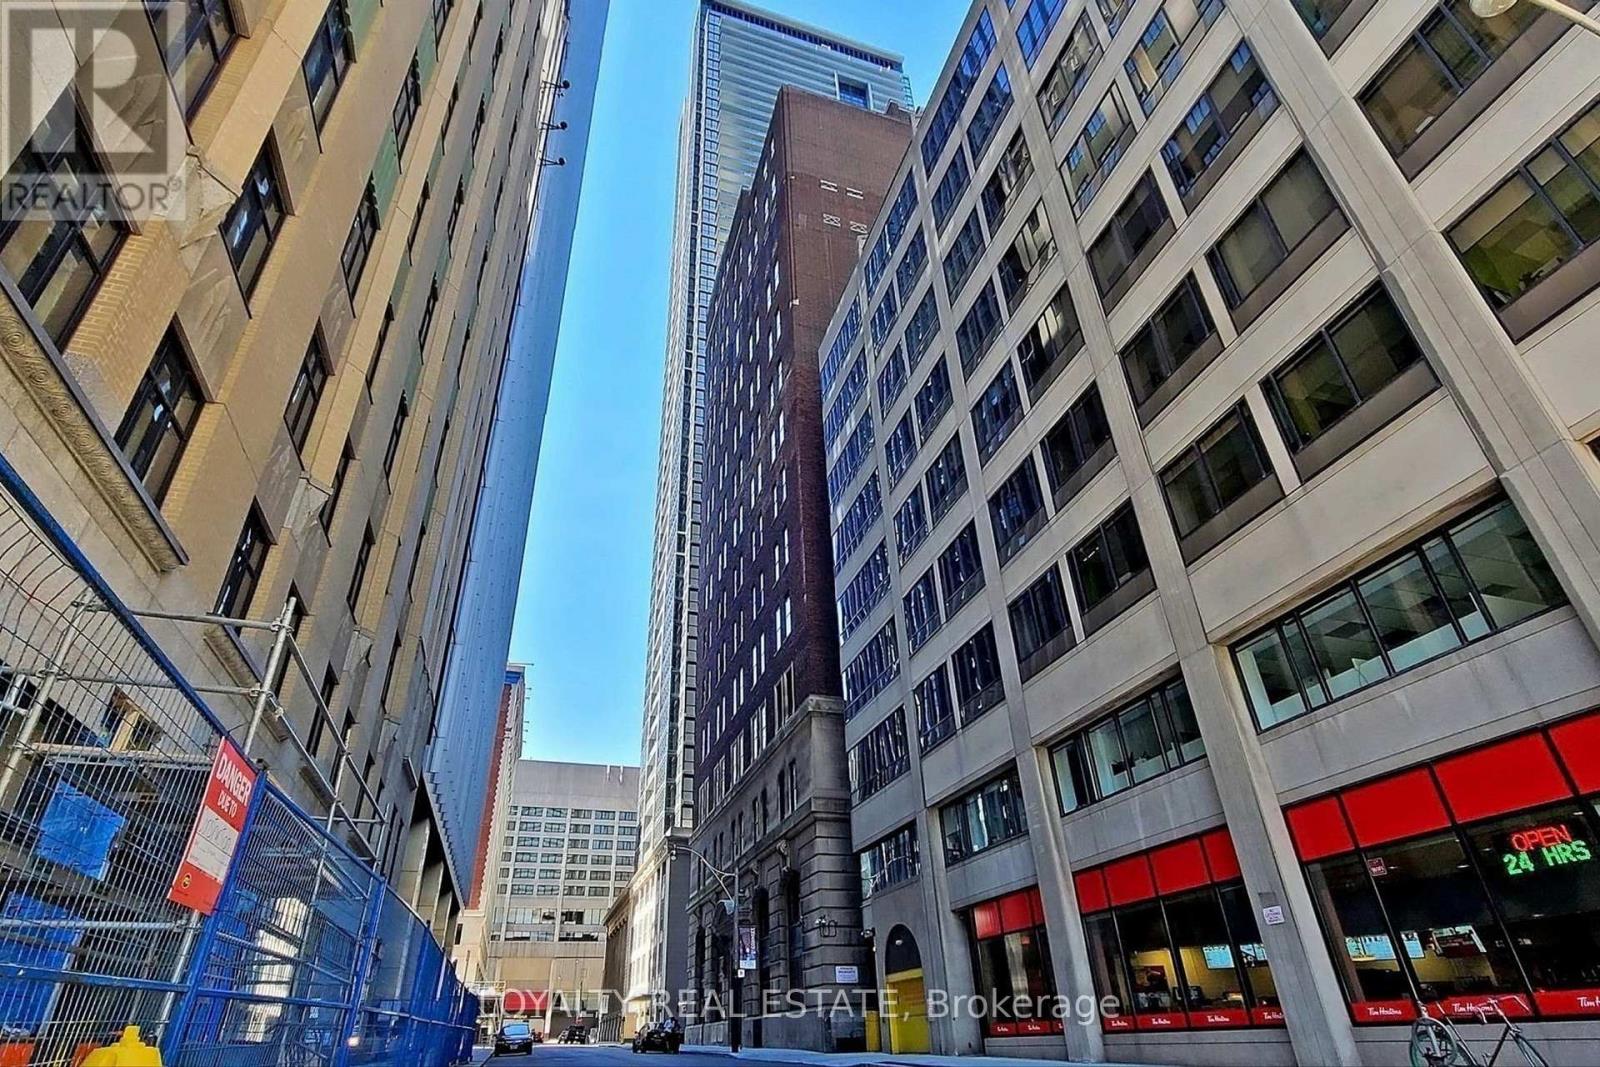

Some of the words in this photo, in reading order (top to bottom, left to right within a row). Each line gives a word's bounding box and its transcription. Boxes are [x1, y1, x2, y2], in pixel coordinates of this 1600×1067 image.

[216, 752, 252, 806] DANGER
[217, 789, 231, 812] DUE
[228, 799, 238, 818] TO
[1511, 824, 1572, 852] OPEN
[1503, 851, 1535, 876] 24
[1541, 839, 1591, 866] HRS
[1367, 1007, 1379, 1016] Tim
[1452, 1003, 1468, 1013] Tim
[1576, 996, 1596, 1008] Tim
